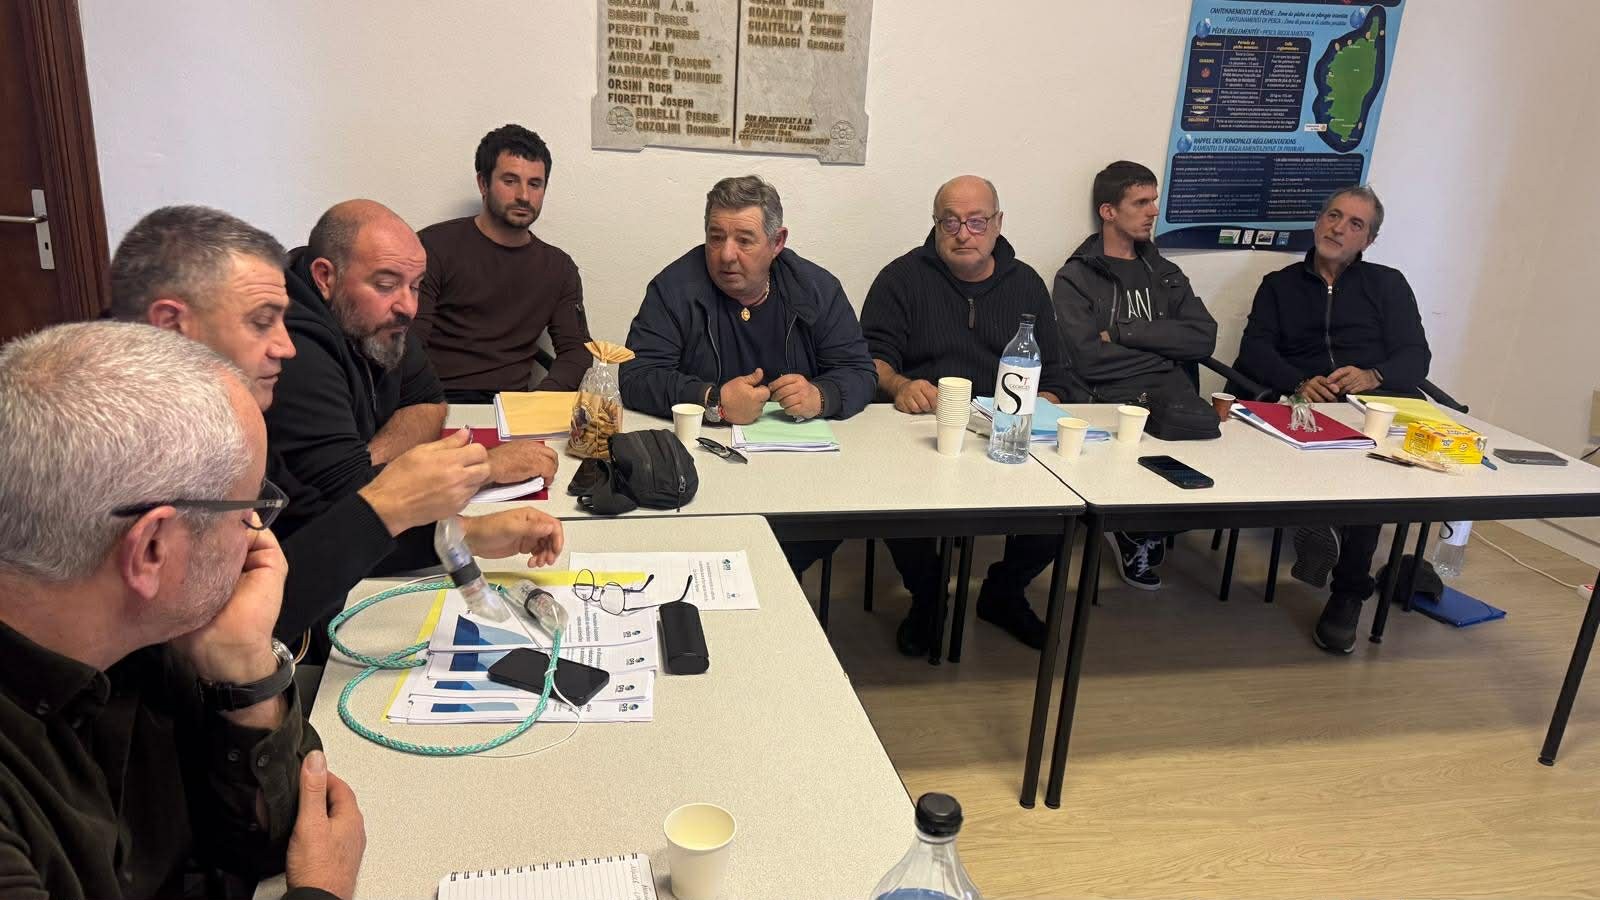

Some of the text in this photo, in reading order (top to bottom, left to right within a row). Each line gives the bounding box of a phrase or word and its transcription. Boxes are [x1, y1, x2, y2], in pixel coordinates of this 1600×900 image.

[654, 12, 689, 26] PIERRE
[608, 23, 700, 40] PERFETTI PIERRE
[608, 37, 675, 53] PIETRI JEAN
[807, 39, 845, 52] GEORGES
[608, 51, 662, 65] ANDREANI
[674, 70, 723, 84] DOMINIQUE
[608, 79, 673, 94] ORSINI ROCH
[608, 93, 694, 108] FIORETTI JOSEPH
[686, 110, 720, 123] PIERRE
[686, 124, 731, 137] DOMINIQUE
[1126, 287, 1152, 322] AN
[997, 372, 1024, 415] S
